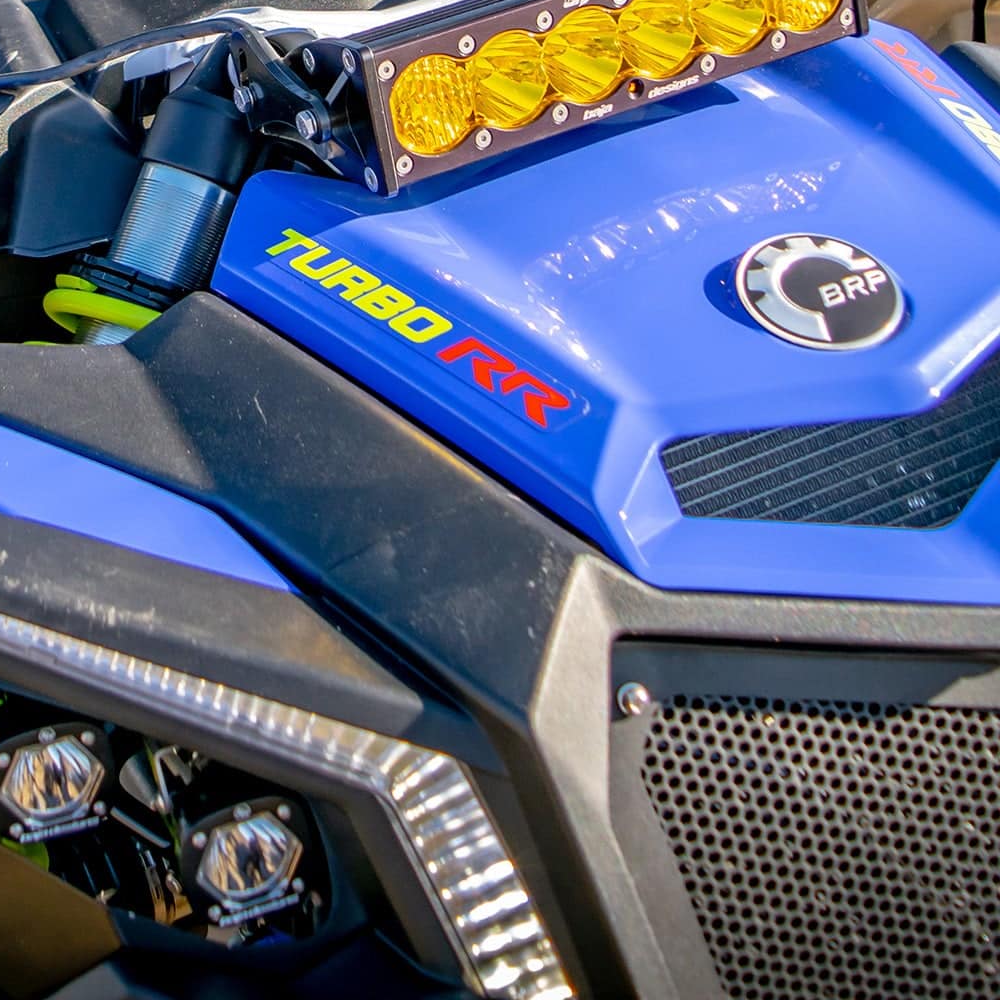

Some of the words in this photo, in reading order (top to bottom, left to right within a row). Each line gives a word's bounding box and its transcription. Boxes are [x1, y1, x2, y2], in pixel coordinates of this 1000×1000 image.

[648, 75, 700, 99] designs
[818, 269, 887, 308] BRP
[265, 228, 453, 344] TURBO
[436, 337, 571, 428] RR
